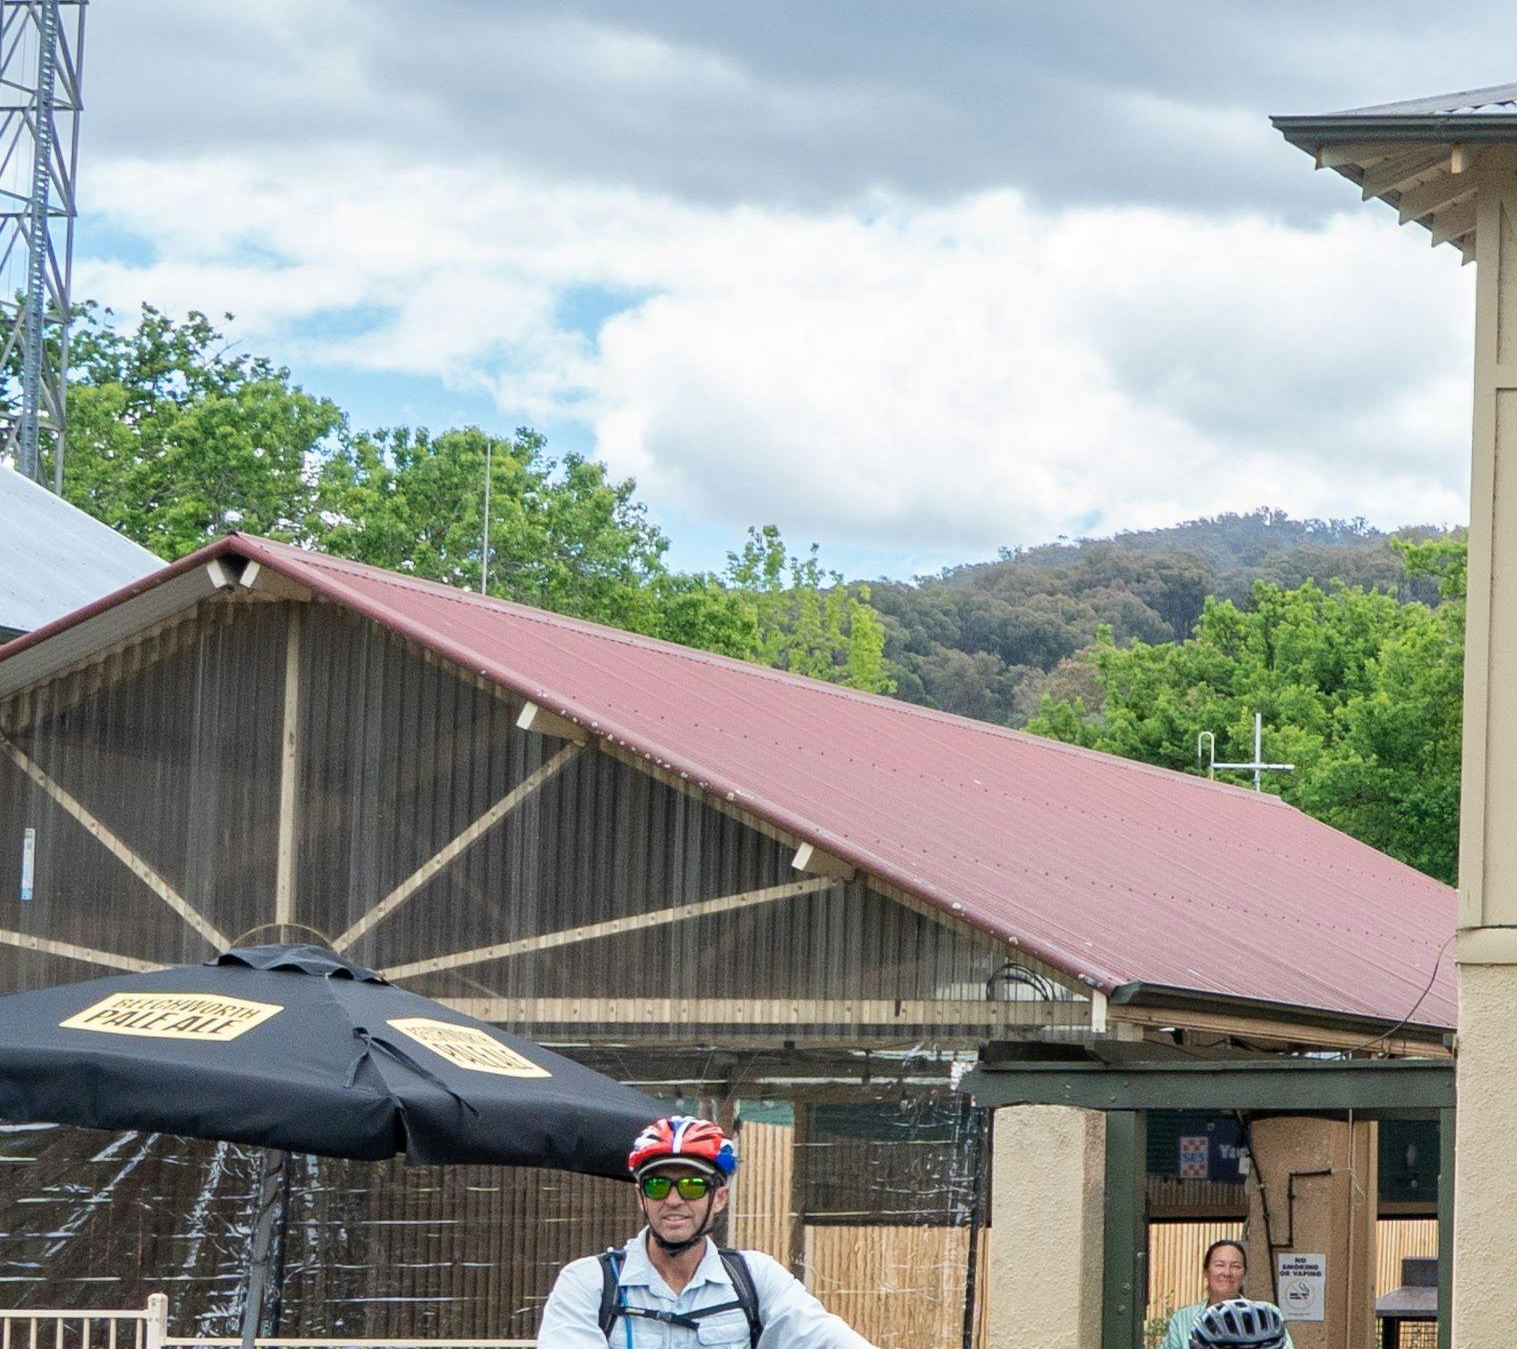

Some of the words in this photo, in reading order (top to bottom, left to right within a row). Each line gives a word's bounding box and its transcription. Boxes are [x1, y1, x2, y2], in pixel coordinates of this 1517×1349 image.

[113, 998, 261, 1019] BEECHWORTH
[83, 1009, 174, 1030] PALE
[163, 1014, 243, 1034] ALE
